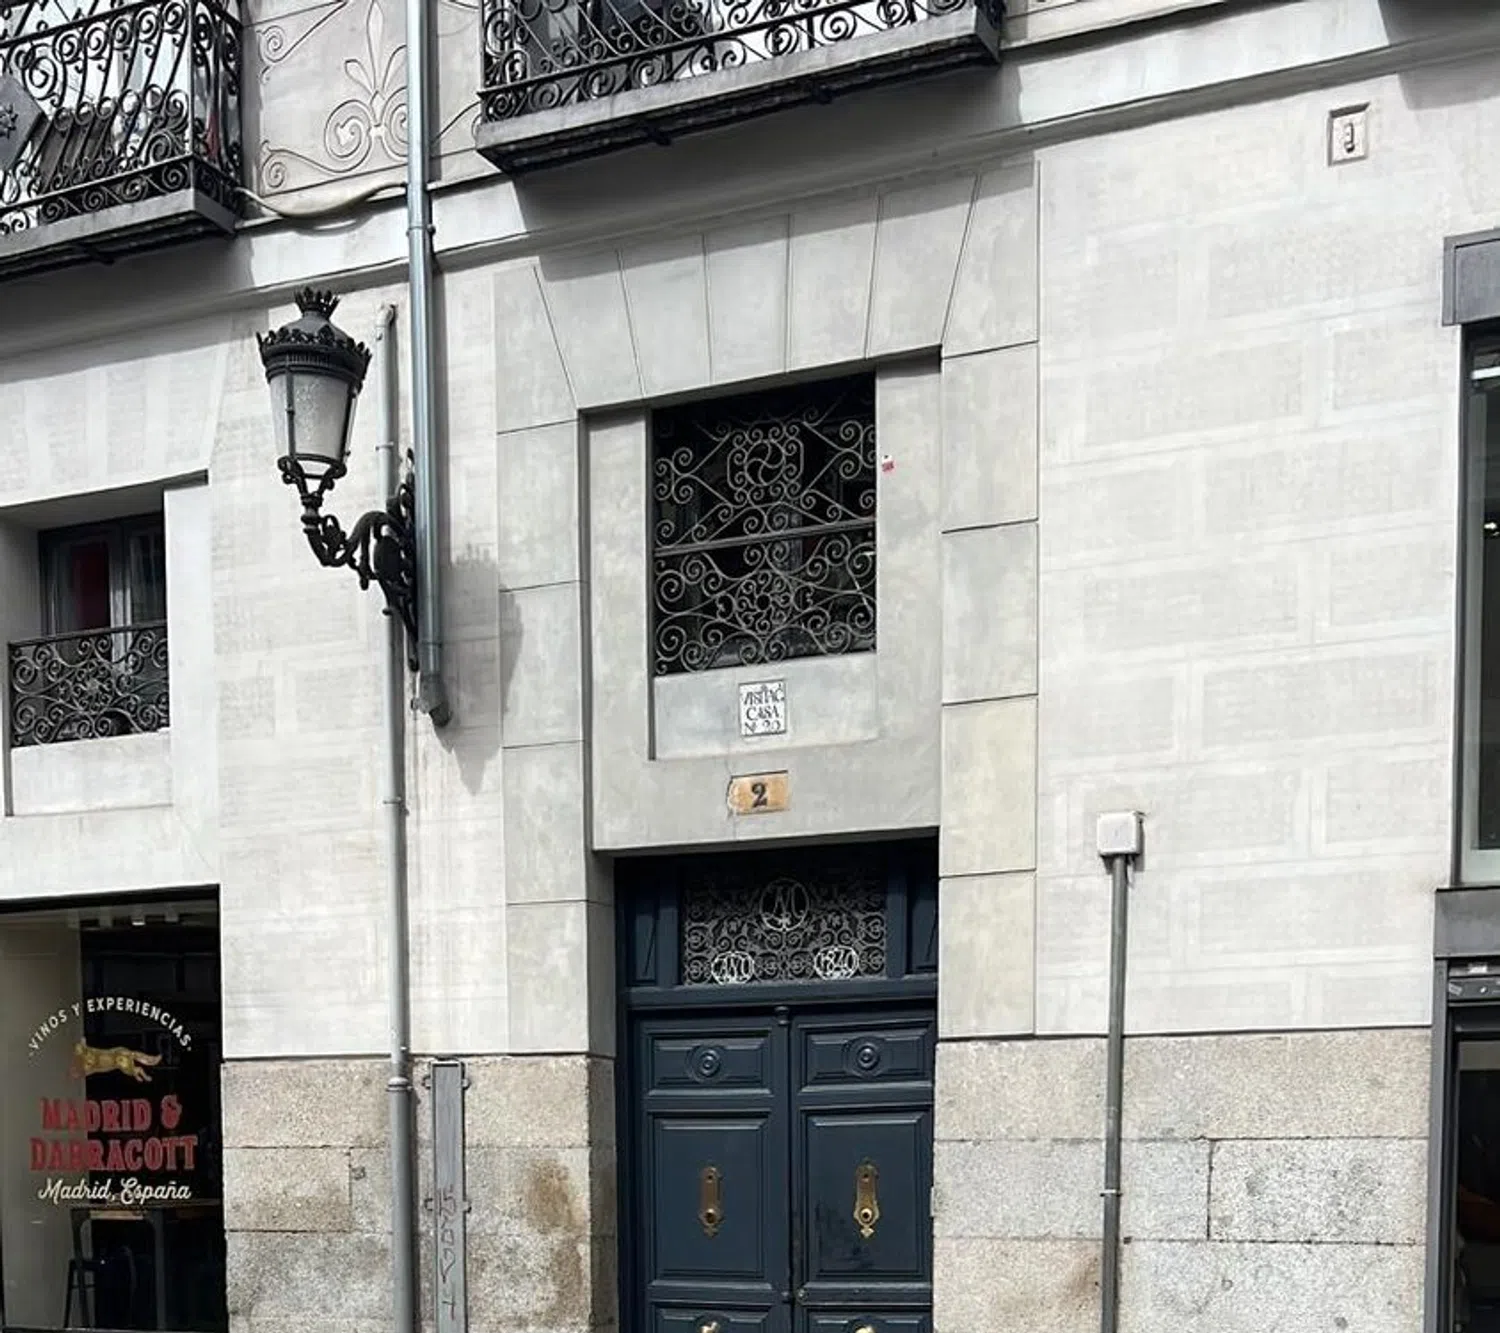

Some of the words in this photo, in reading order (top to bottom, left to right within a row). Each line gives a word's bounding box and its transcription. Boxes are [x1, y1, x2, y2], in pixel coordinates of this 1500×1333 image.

[746, 705, 780, 721] CASA
[751, 782, 768, 808] 2
[71, 1002, 81, 1017] Y
[40, 1097, 151, 1132] MADRID
[160, 1094, 182, 1129] &
[38, 1177, 116, 1204] Madrid,
[120, 1177, 192, 1205] España
